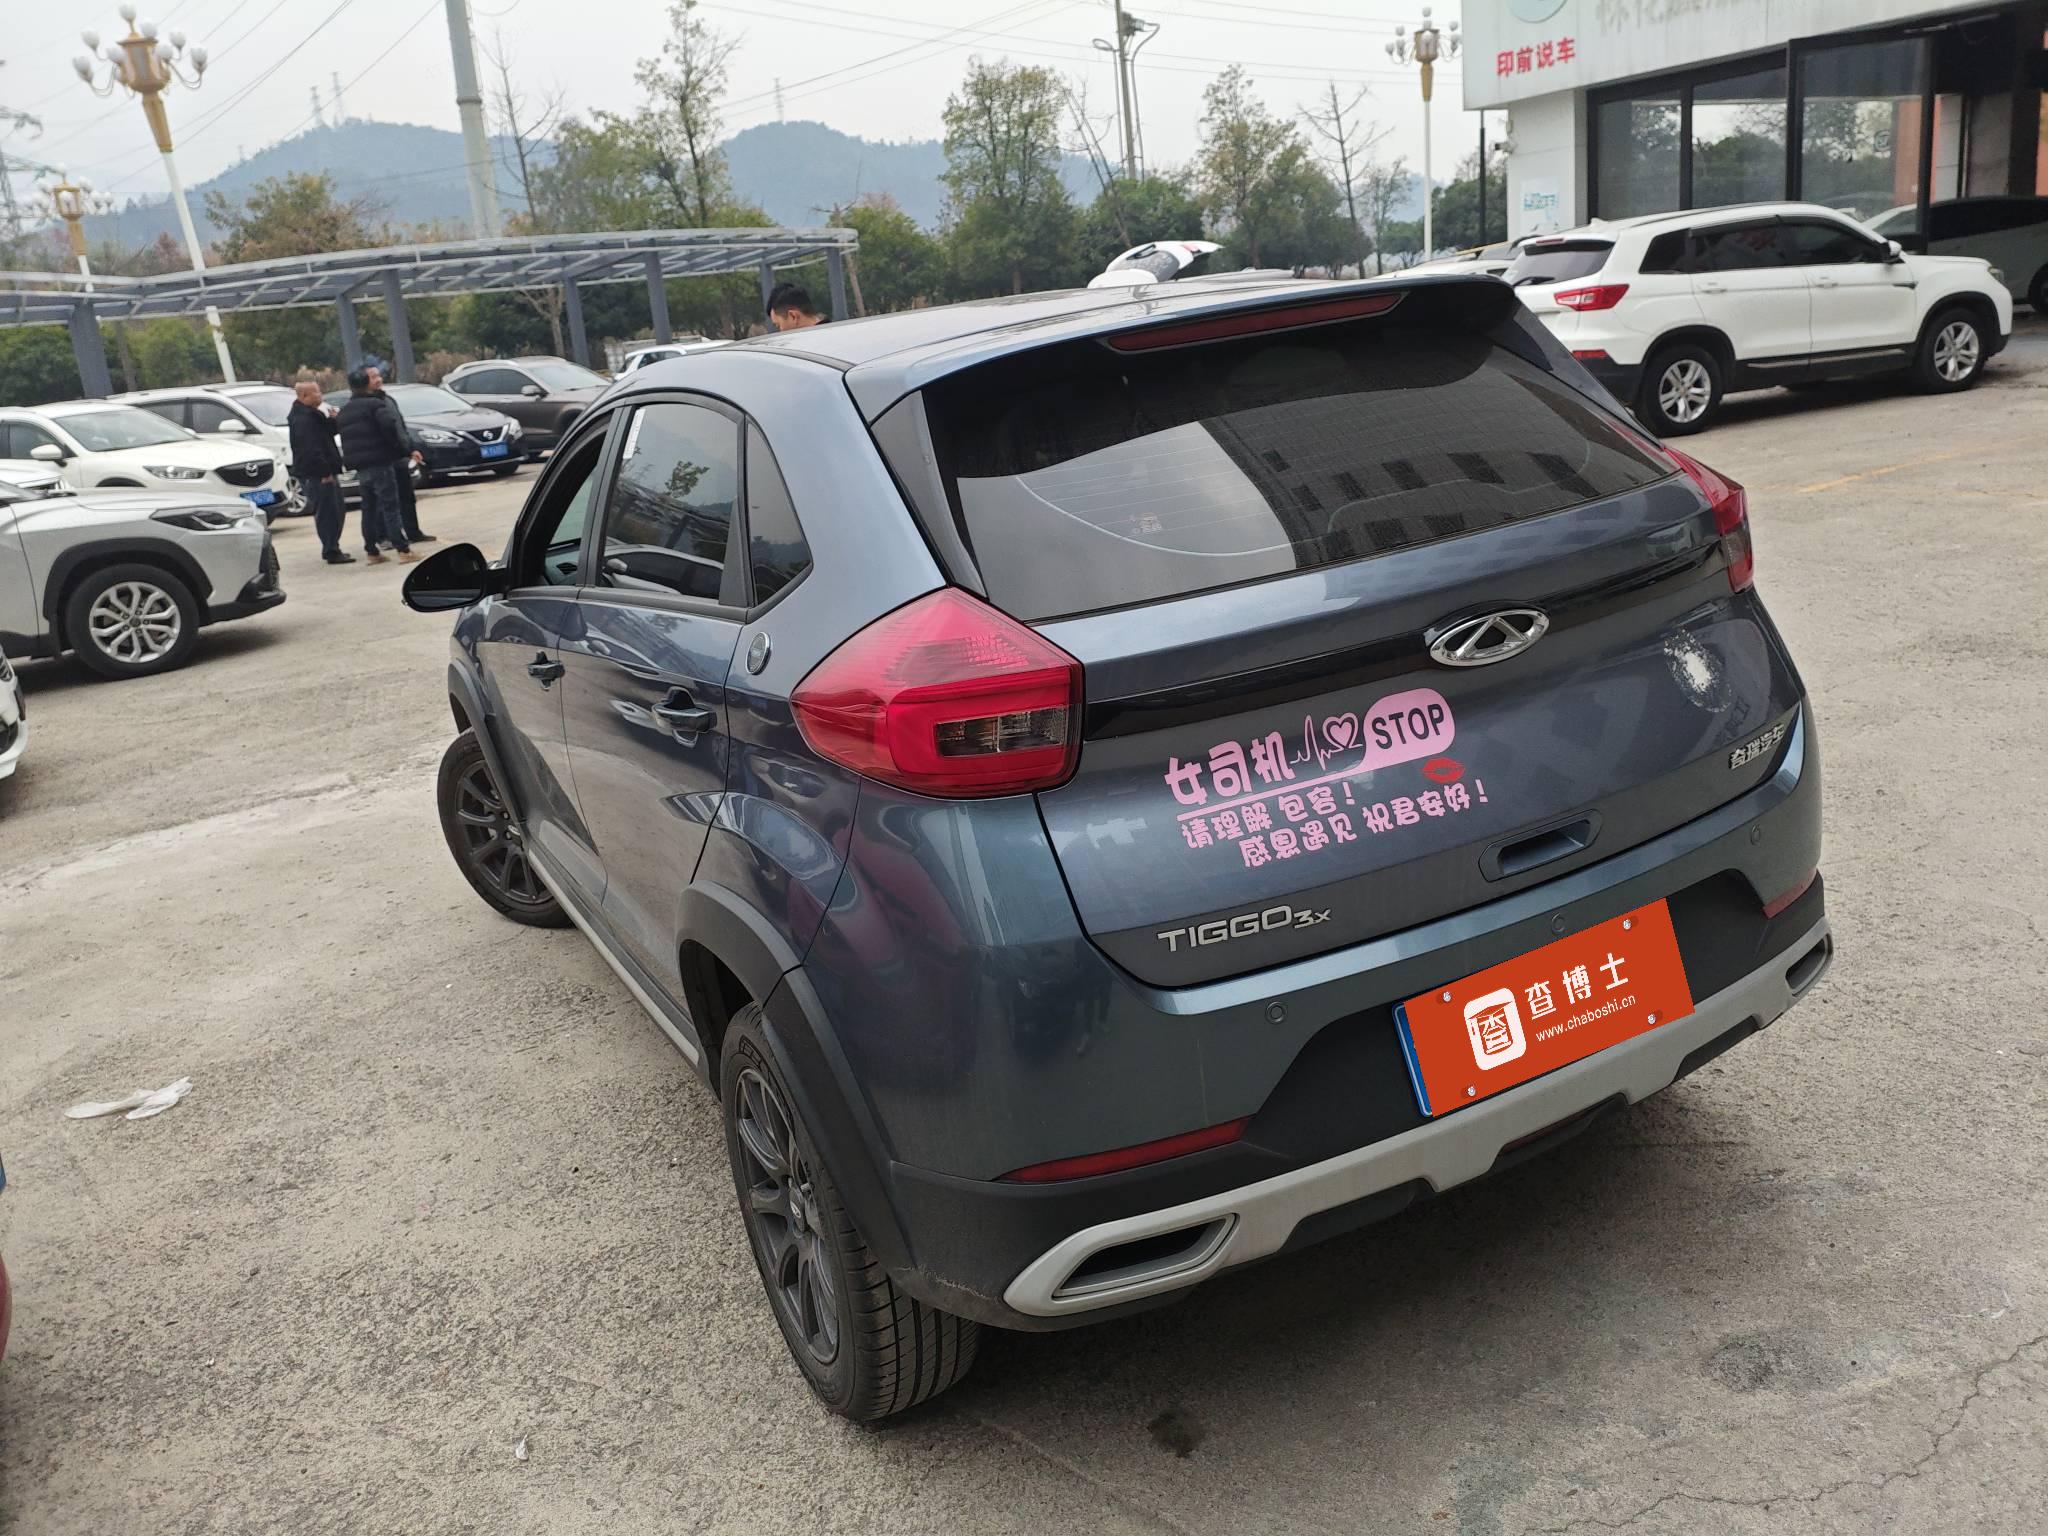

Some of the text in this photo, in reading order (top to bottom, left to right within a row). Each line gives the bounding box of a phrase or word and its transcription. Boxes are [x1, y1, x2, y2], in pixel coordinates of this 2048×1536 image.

[1371, 703, 1445, 750] STOP
[1164, 731, 1296, 806] 女司机
[1182, 801, 1273, 850] 请理解
